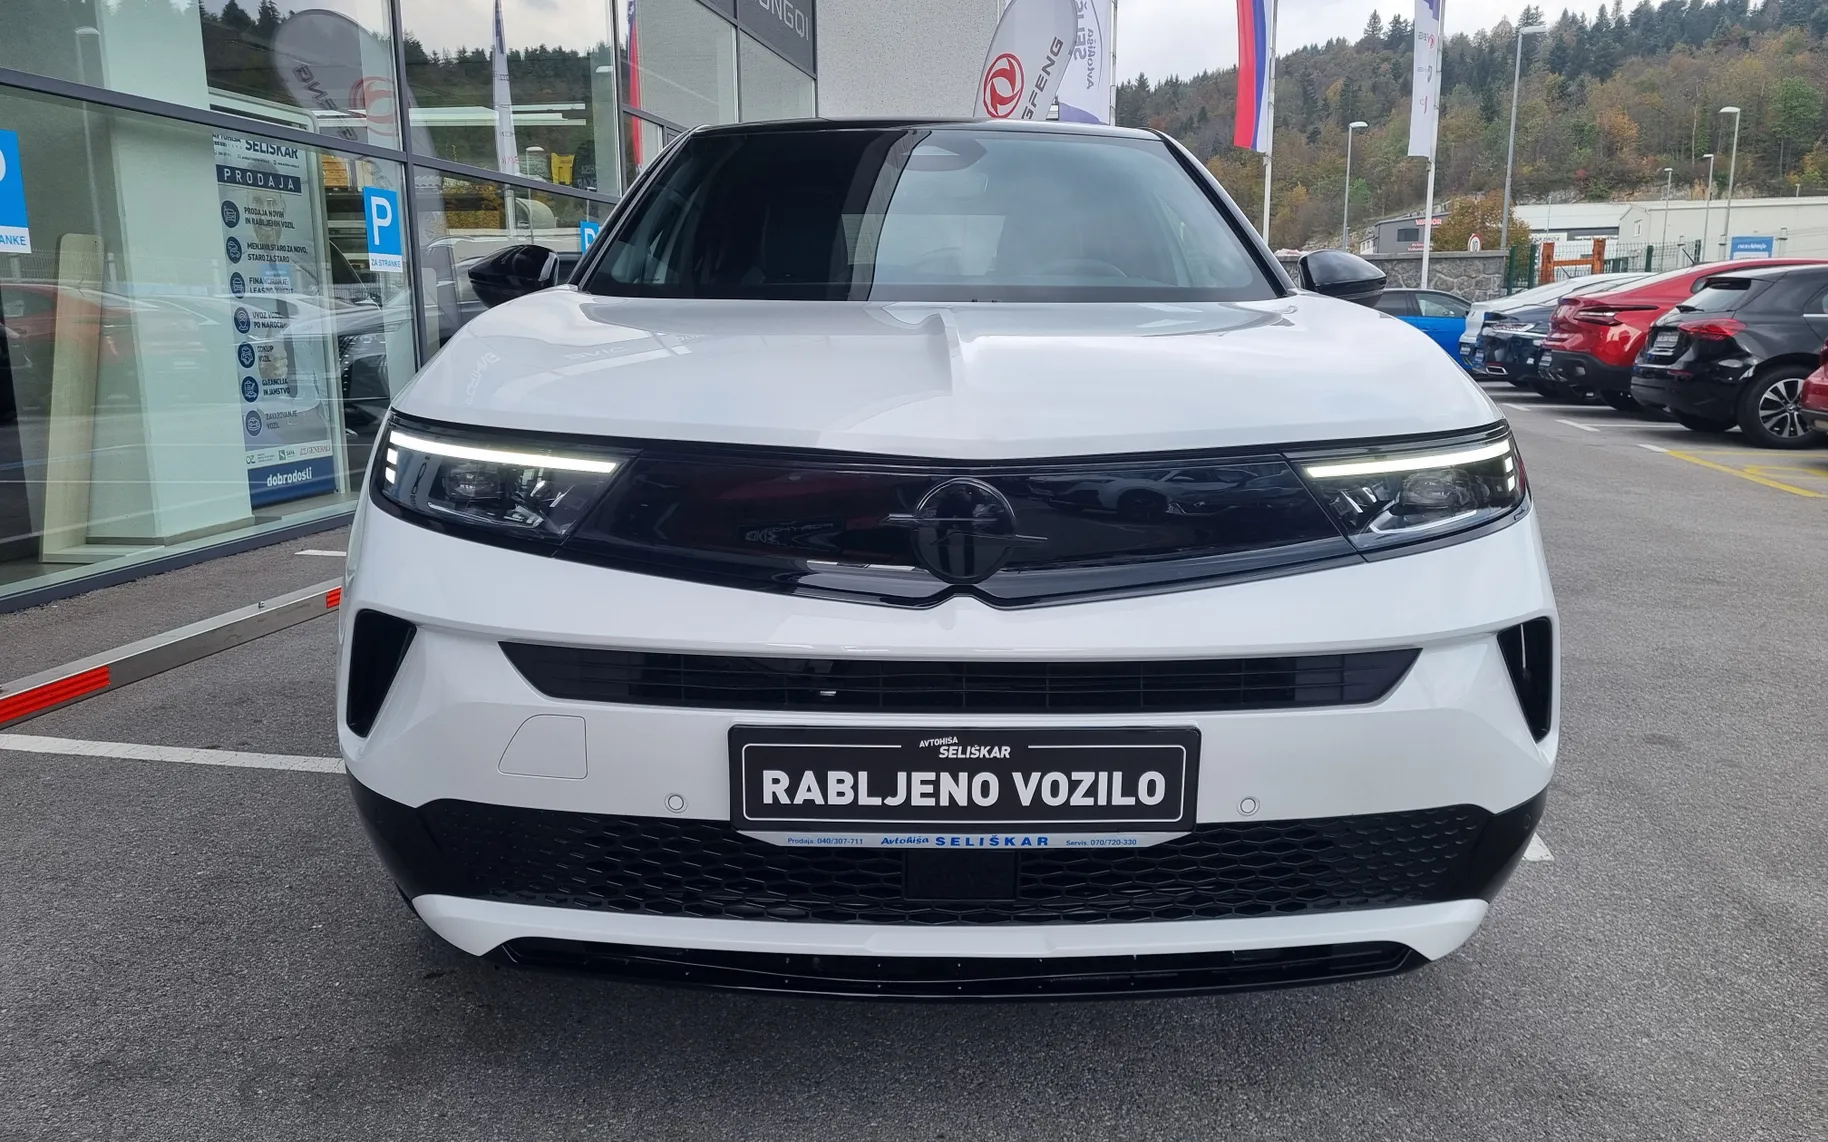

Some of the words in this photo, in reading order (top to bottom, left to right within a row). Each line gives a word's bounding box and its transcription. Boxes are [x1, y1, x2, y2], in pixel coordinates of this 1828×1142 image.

[224, 168, 295, 190] PRODAJA
[244, 206, 268, 216] PRODAJA
[268, 209, 285, 218] NOVIH
[245, 217, 251, 225] IN
[251, 218, 280, 227] RABLJENIH
[371, 196, 392, 245] P
[270, 243, 287, 252] STARO
[287, 245, 294, 253] ZA
[247, 253, 265, 262] STARO
[265, 254, 274, 262] ZA
[274, 255, 289, 263] STARO
[371, 258, 378, 266] ZA
[378, 258, 401, 268] STRANKE
[252, 311, 267, 319] UVOZ
[253, 321, 260, 329] PO
[263, 388, 268, 396] IN
[268, 387, 290, 396] JAMSTVO
[266, 466, 312, 487] dobrodošli
[938, 744, 1011, 758] SELIŠKAR
[762, 770, 1000, 807] RABLJENO
[1012, 771, 1166, 807] VOZILO
[817, 837, 863, 845] 040/307-711
[880, 835, 929, 845] Avtohiša
[935, 835, 1049, 847] SELIŠKAR
